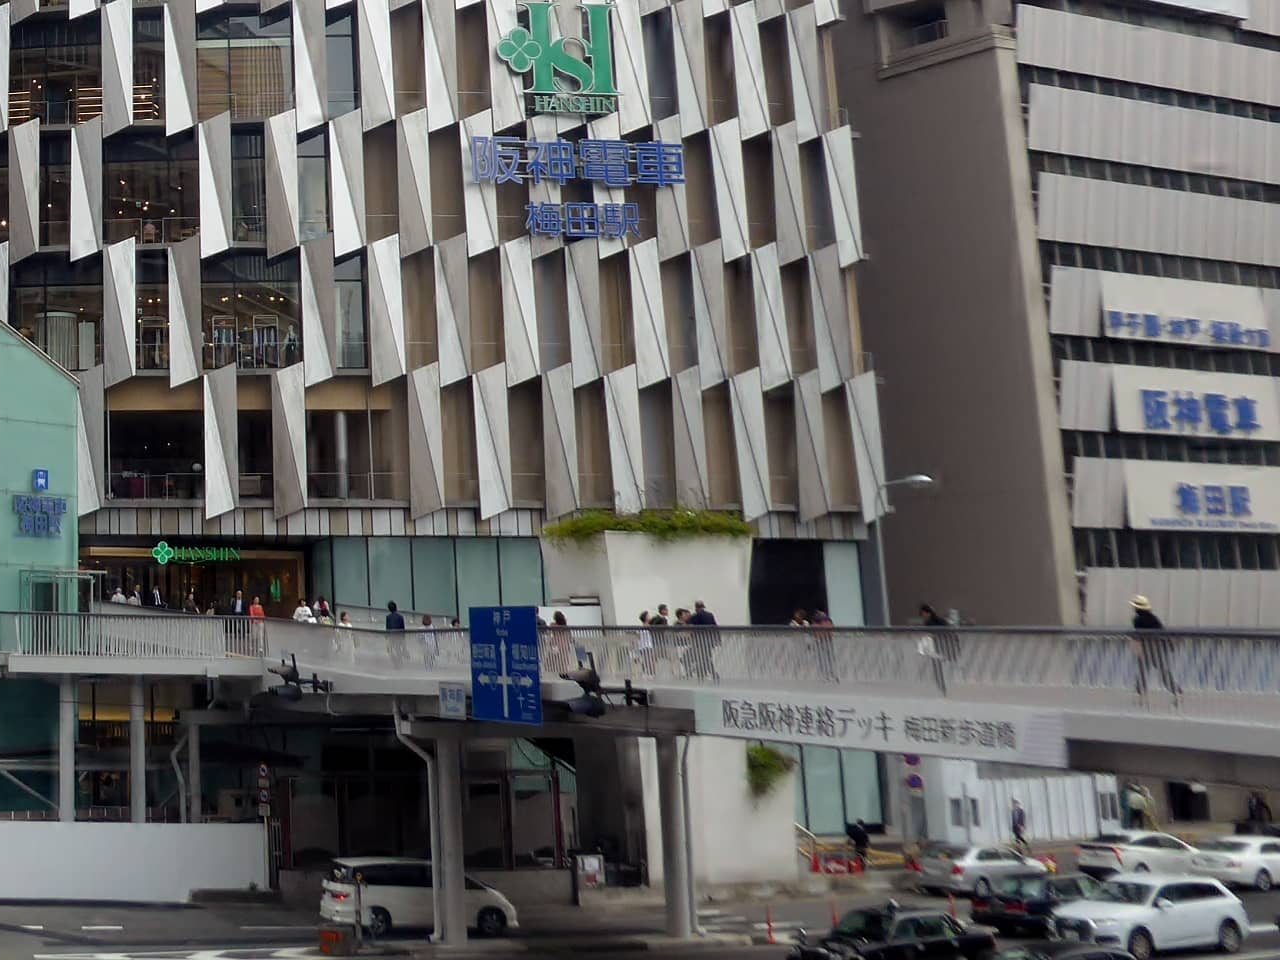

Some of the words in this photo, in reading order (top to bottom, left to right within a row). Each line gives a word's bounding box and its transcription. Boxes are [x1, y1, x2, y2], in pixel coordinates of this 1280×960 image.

[534, 95, 616, 114] HANSHIN
[471, 136, 686, 188] 阪神電車
[525, 200, 641, 240] 梅田駅
[174, 545, 241, 561] HANSHIN
[722, 699, 896, 742] 阪急阪神連絡デッキ
